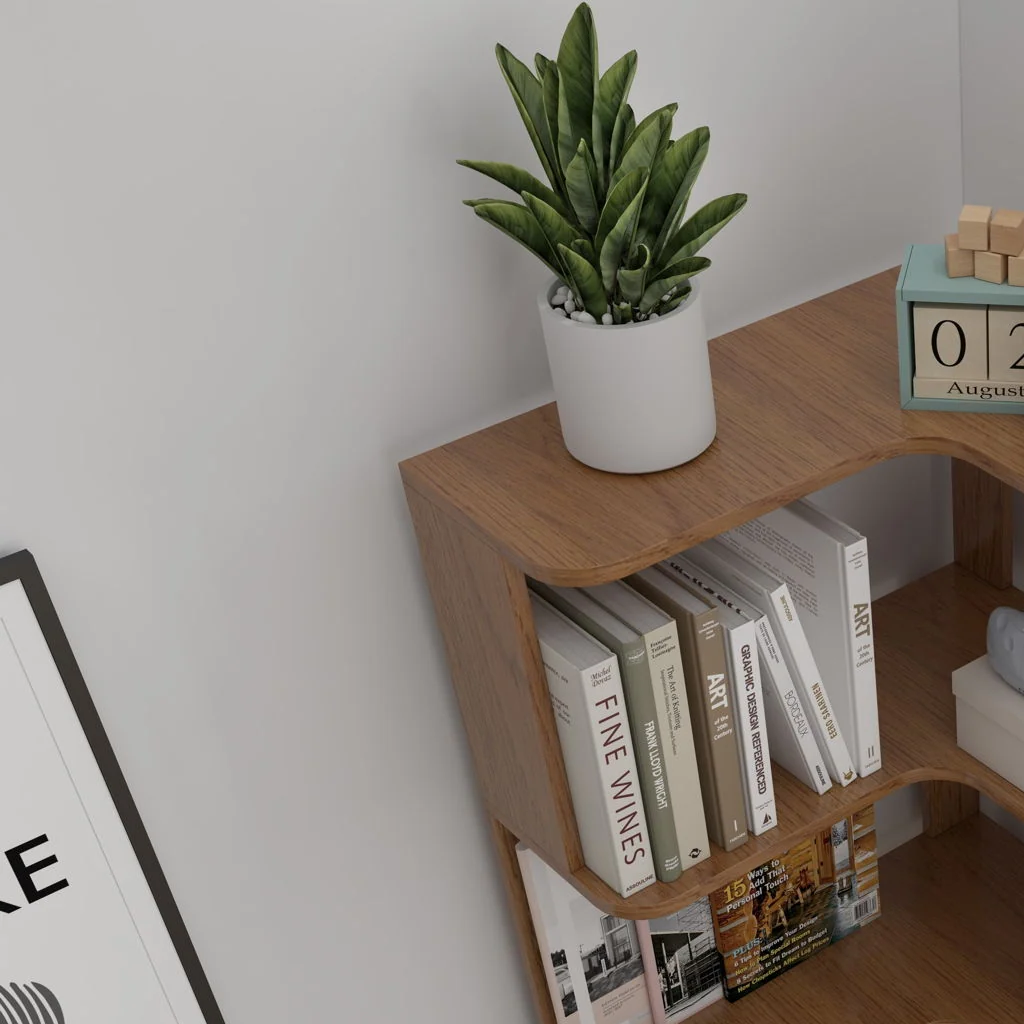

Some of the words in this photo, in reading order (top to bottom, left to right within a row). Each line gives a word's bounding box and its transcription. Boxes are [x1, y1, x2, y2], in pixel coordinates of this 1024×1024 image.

[854, 603, 870, 638] ART
[741, 644, 755, 692] GRAPHIC
[669, 680, 677, 694] Art
[672, 692, 678, 702] of
[708, 674, 728, 710] ART
[811, 682, 830, 720] SAARINEN
[673, 700, 682, 730] Knitting
[746, 692, 760, 731] DESIGN
[784, 690, 808, 738] BORDEAUX
[595, 694, 628, 766] FINE
[644, 720, 658, 750] FRANK
[825, 720, 838, 740] EERO
[650, 749, 662, 777] LLOYD
[750, 730, 767, 795] REFERENCED
[654, 776, 668, 810] WRIGHT
[610, 770, 645, 865] WINES
[724, 878, 746, 904] 15
[747, 864, 768, 881] Ways
[771, 859, 780, 868] to
[726, 890, 763, 912] Personal
[764, 874, 789, 892] Touch
[749, 877, 765, 890] Add
[768, 866, 786, 880] That
[770, 944, 790, 956] Special
[792, 930, 811, 944] Rooms
[784, 928, 798, 938] Your
[799, 916, 818, 932] Design
